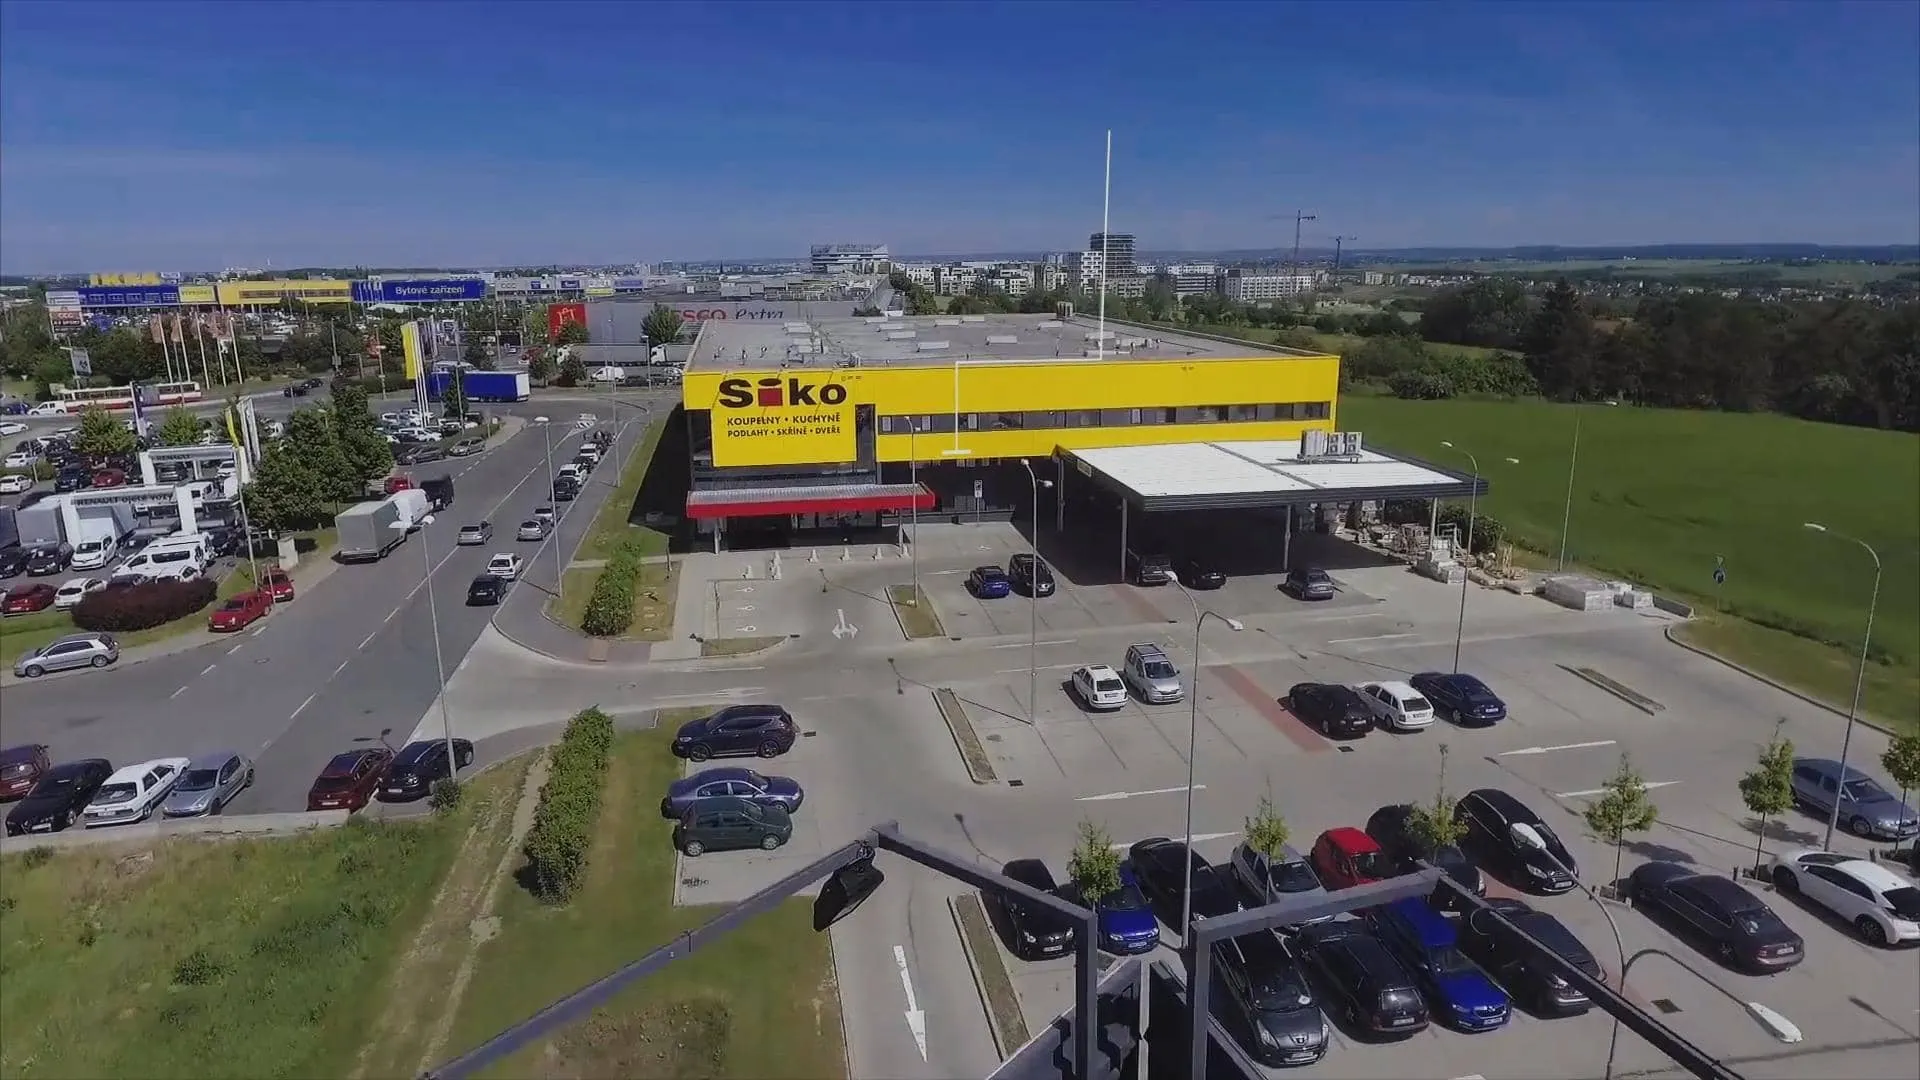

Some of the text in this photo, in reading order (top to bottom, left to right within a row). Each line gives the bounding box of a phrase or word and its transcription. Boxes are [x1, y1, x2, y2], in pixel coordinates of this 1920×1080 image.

[395, 284, 465, 296] Bytové zařízení
[719, 378, 847, 408] Siko
[727, 412, 841, 426] KOUPELNY KUCHYNĚ
[727, 426, 841, 438] PODLAHY SKŘÍNĚ DVEŘE
